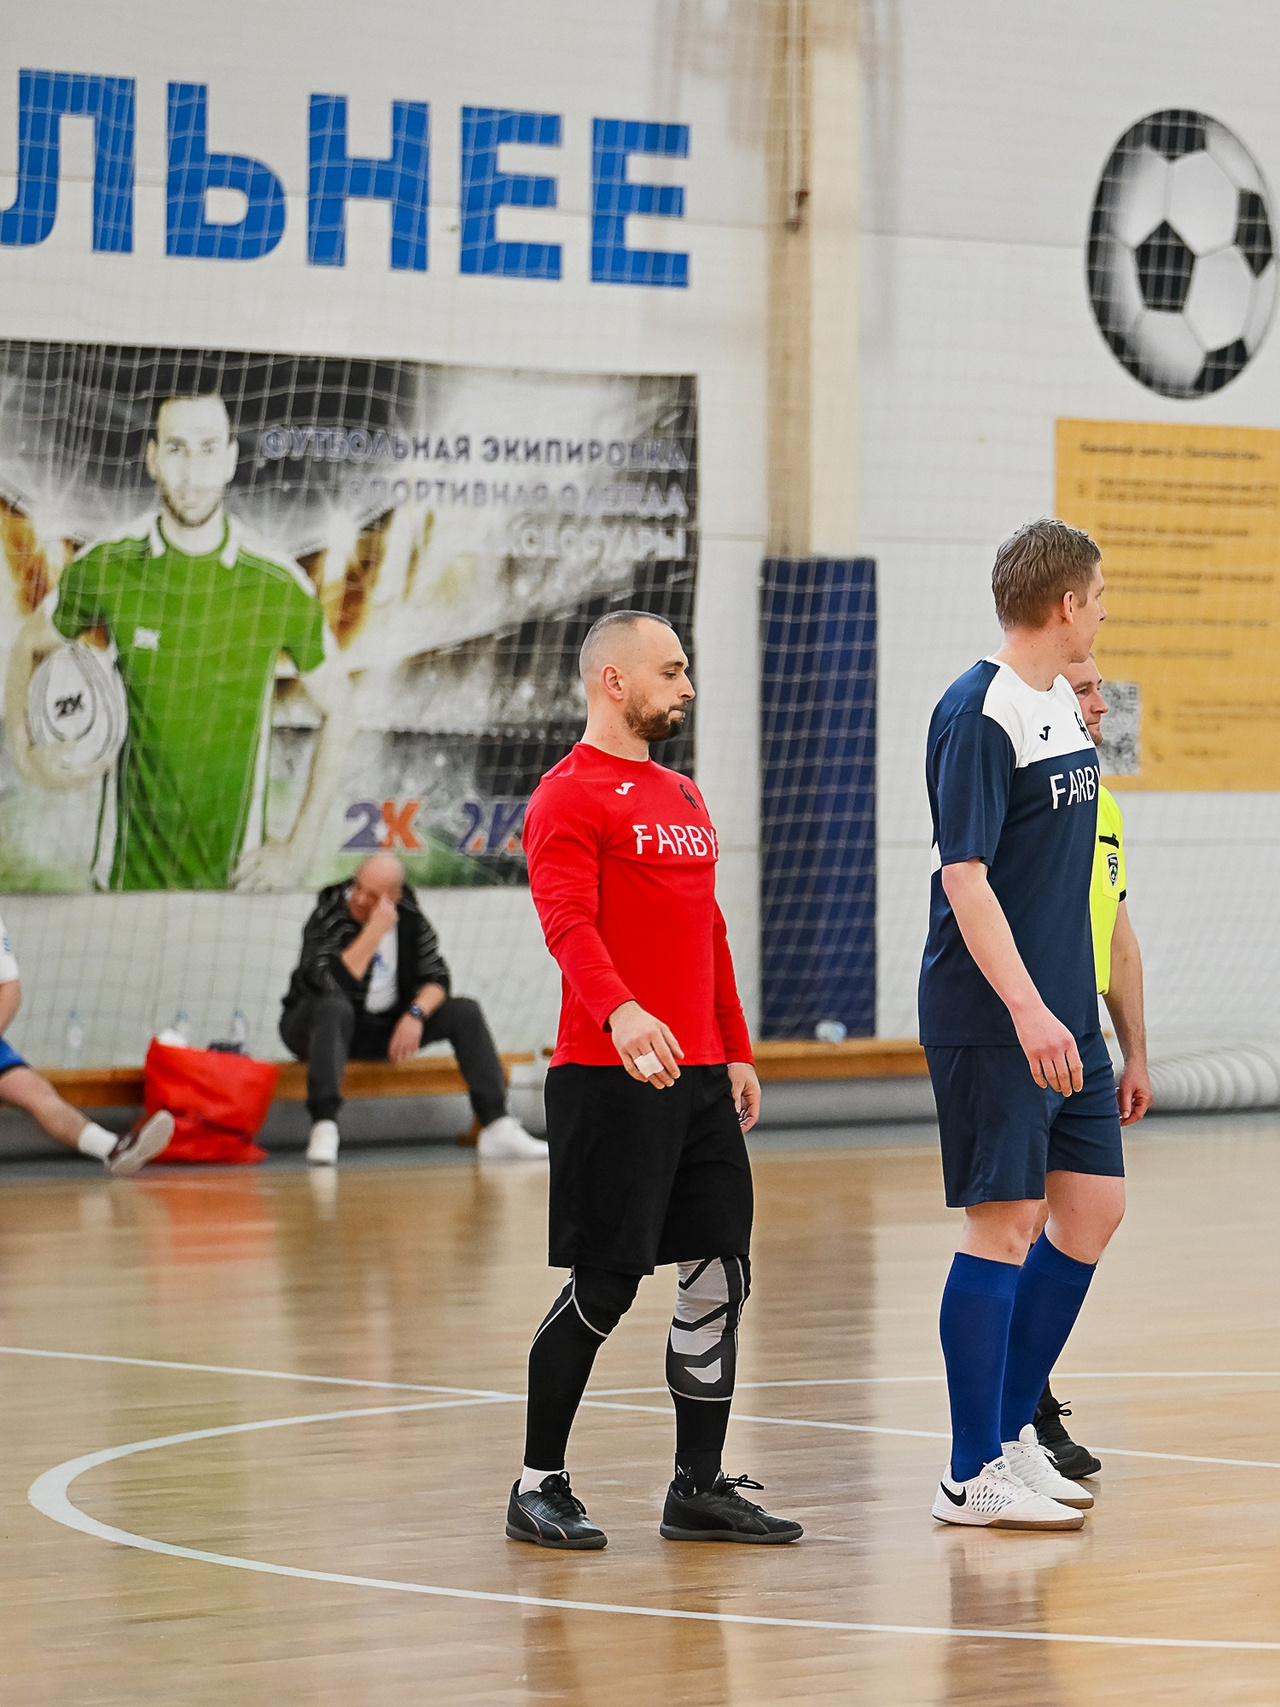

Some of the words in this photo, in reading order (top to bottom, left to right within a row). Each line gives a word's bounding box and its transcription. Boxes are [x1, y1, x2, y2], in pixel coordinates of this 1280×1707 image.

[0, 67, 691, 289] ЛЬНЕЕ
[260, 427, 472, 464] ФУТБОЛЬНАЯ
[481, 435, 690, 473] ЭКИПИРОВКА
[632, 823, 717, 859] FARBY
